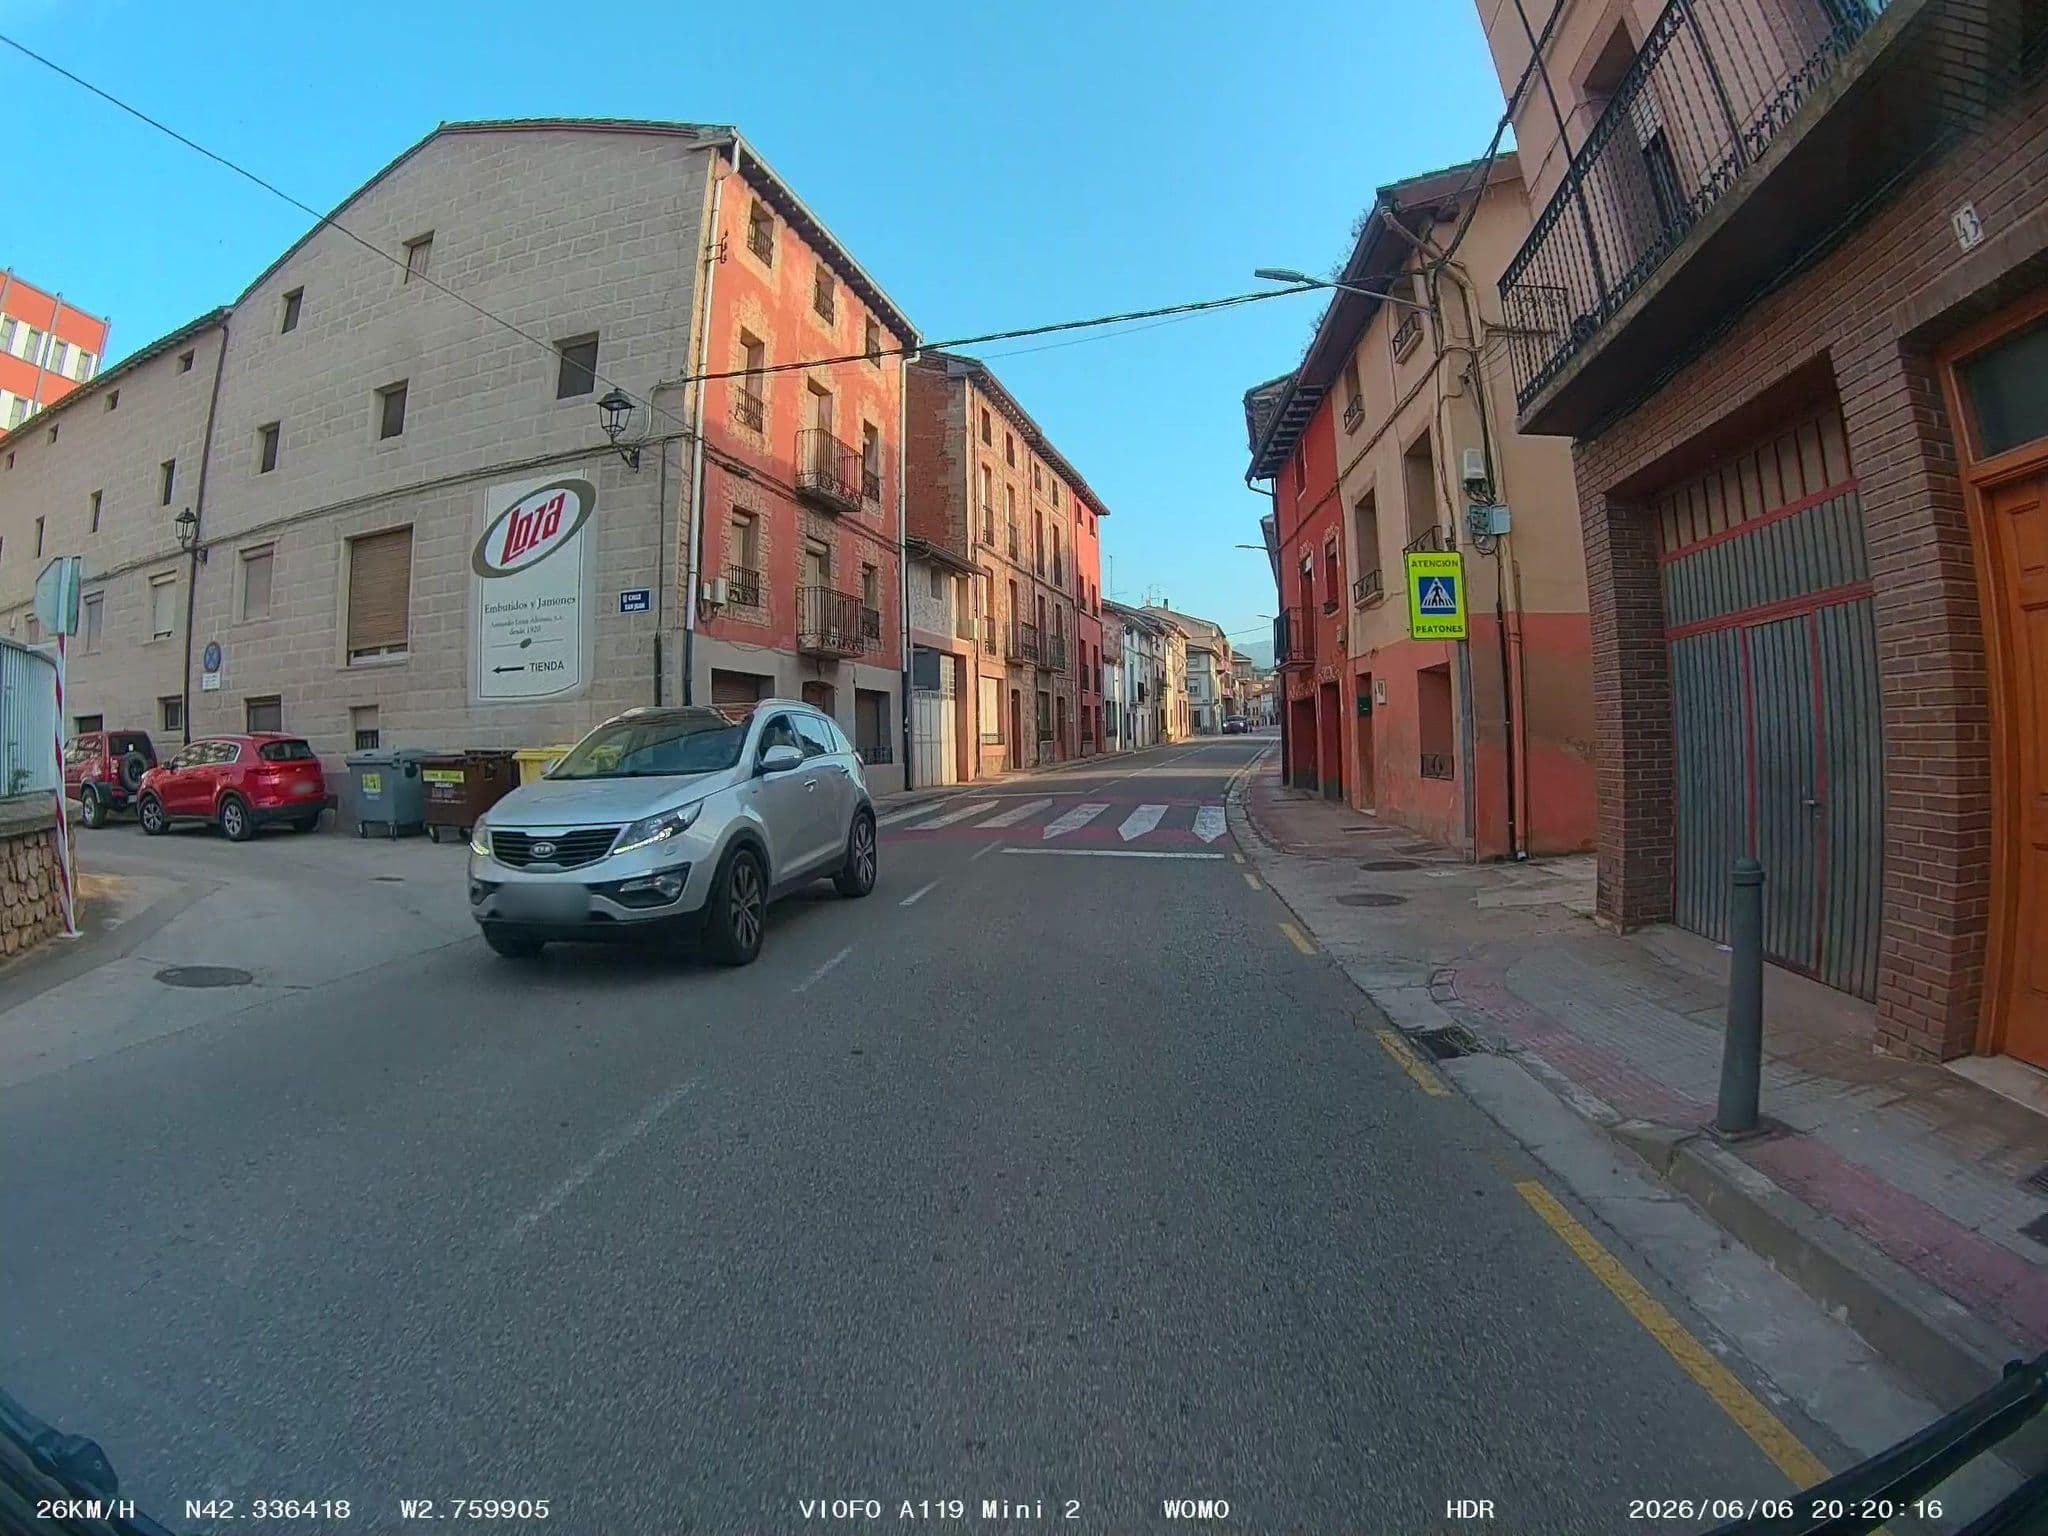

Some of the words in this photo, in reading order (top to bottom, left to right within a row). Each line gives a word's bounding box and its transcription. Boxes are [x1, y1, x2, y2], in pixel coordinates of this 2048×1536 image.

[1956, 208, 1981, 244] 43
[484, 601, 528, 614] Embutidos
[536, 597, 576, 610] Jamones
[1416, 625, 1464, 633] PEATONES
[529, 660, 565, 673] TIENDA
